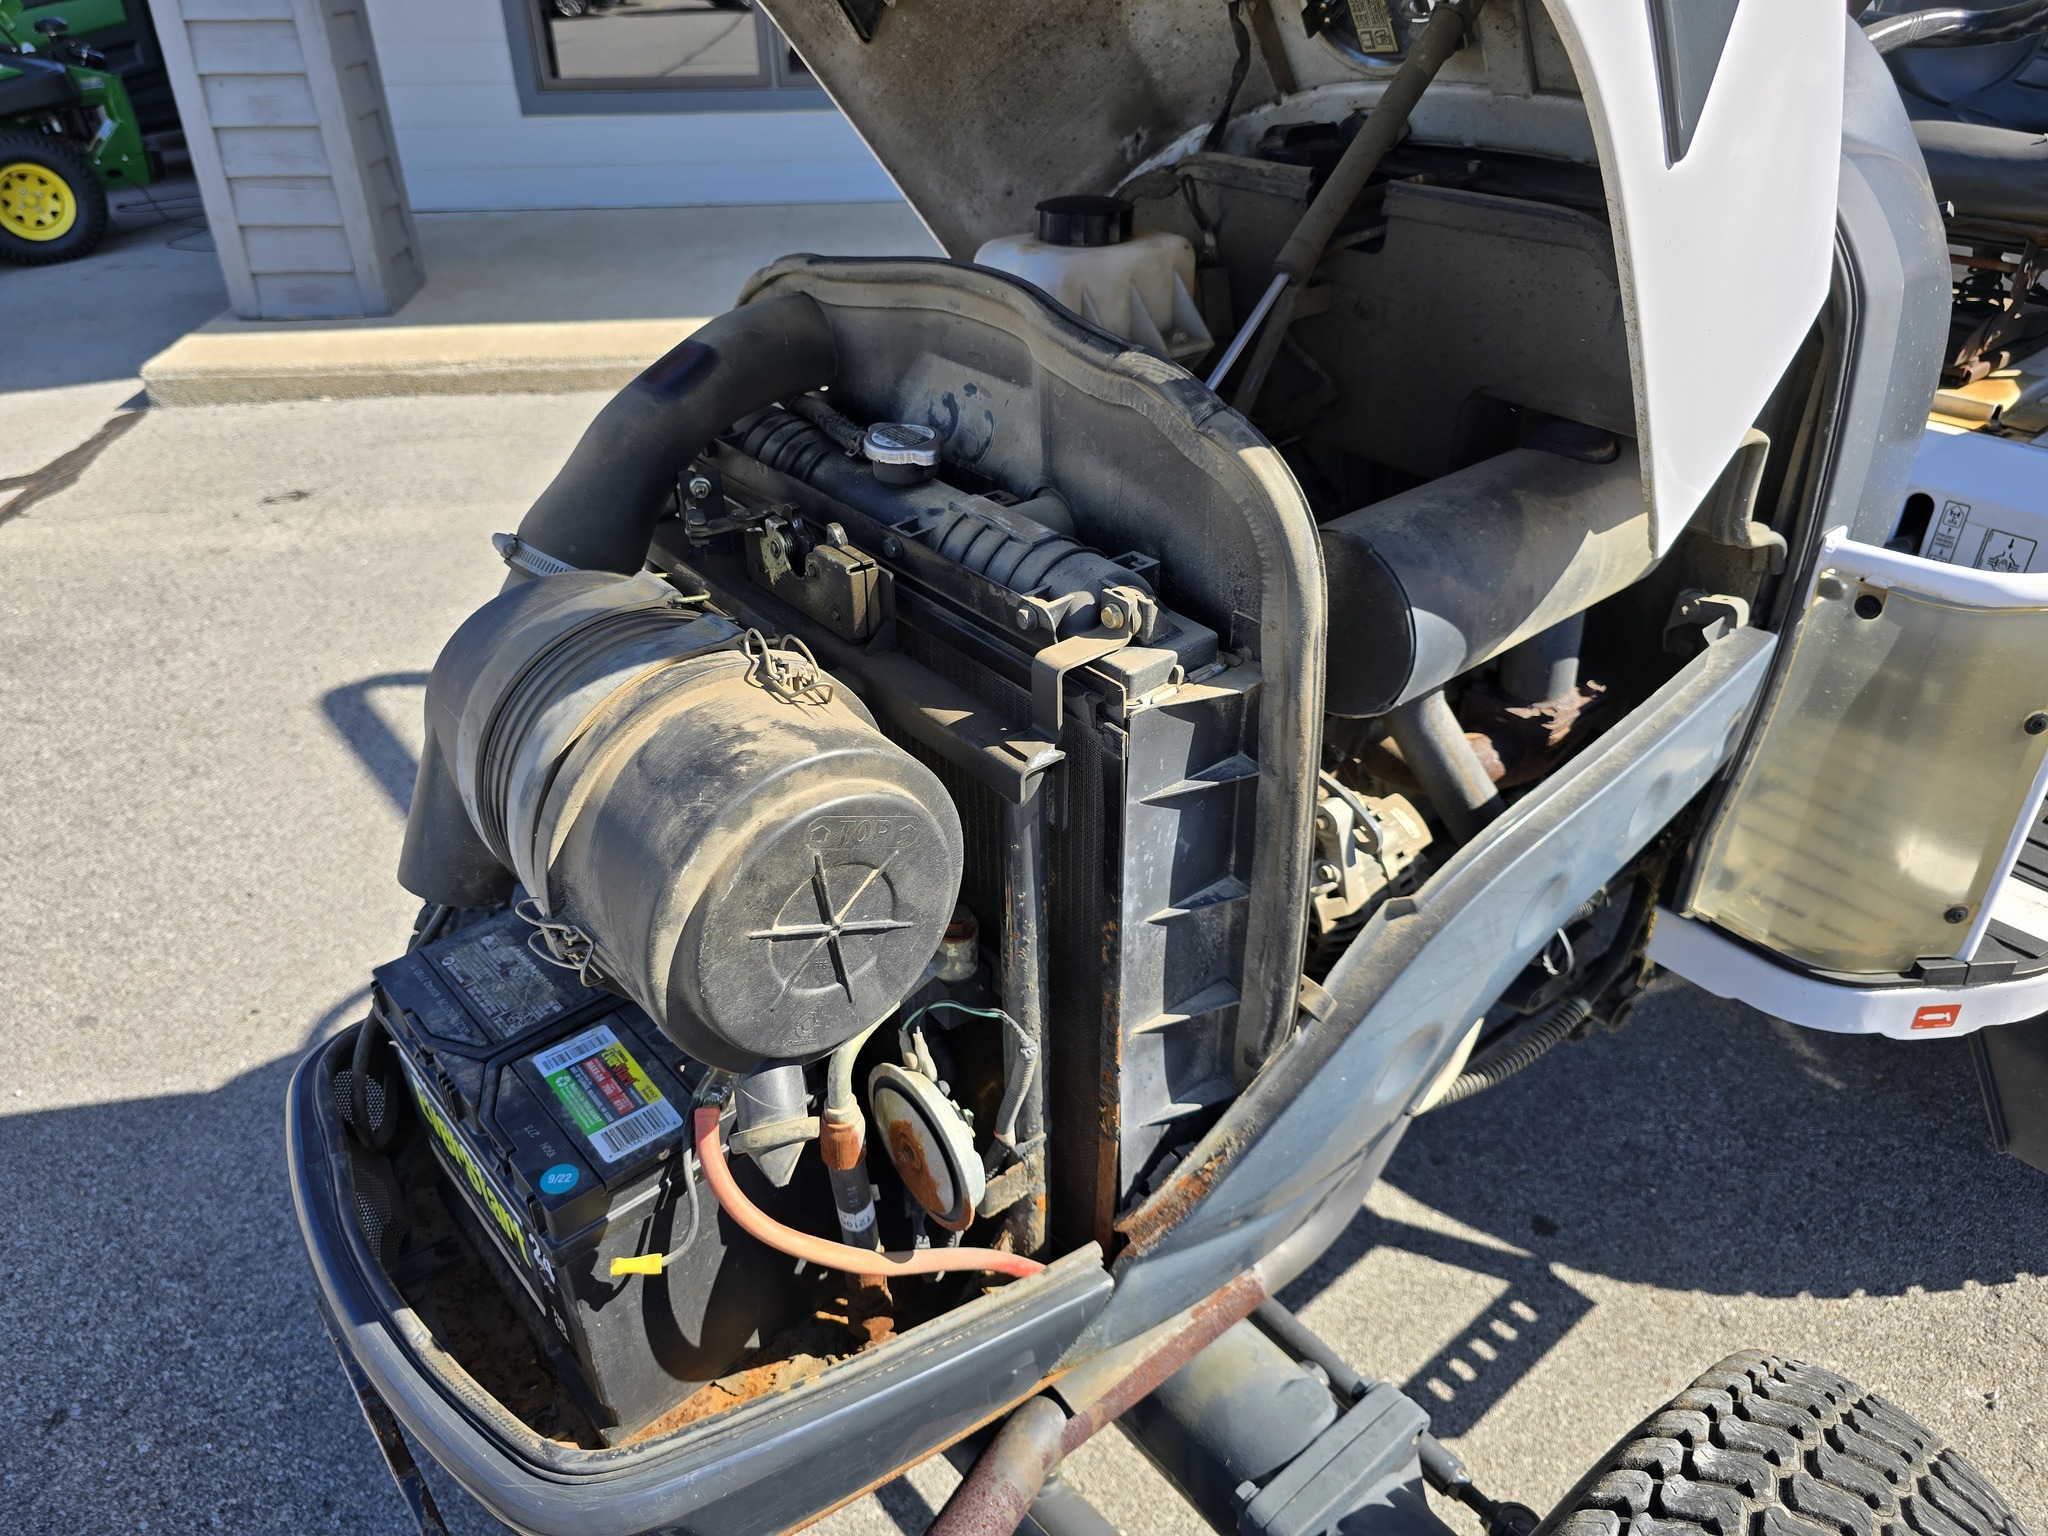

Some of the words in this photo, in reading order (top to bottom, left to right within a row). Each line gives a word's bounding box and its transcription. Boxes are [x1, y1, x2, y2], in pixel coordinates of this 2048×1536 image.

[839, 819, 895, 848] TOP
[601, 1047, 638, 1086] EverStart
[547, 1172, 572, 1184] 9/22
